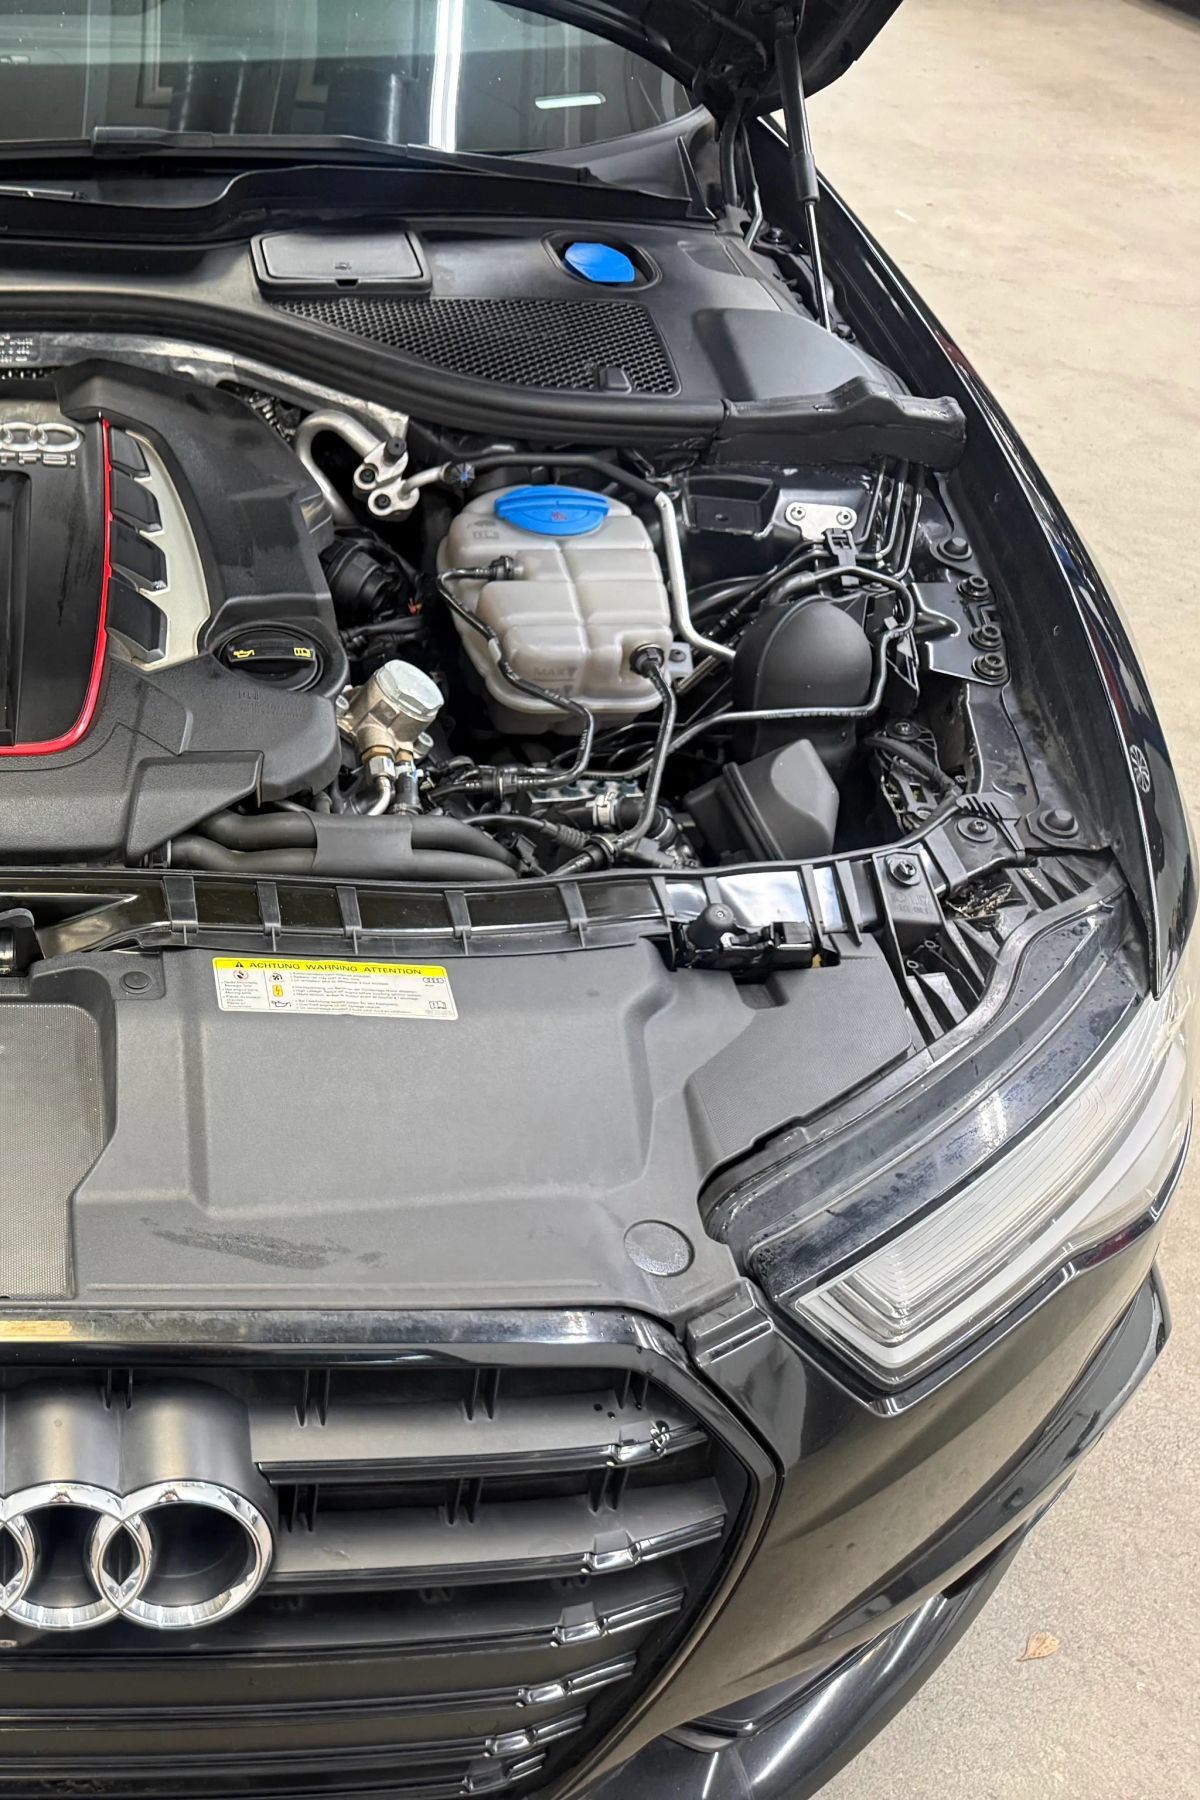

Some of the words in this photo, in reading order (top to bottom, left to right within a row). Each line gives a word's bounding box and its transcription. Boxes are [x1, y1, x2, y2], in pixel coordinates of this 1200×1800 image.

[249, 961, 301, 970] ACHTUNG
[305, 963, 358, 972] WARNING
[363, 966, 422, 975] ATTENTION
